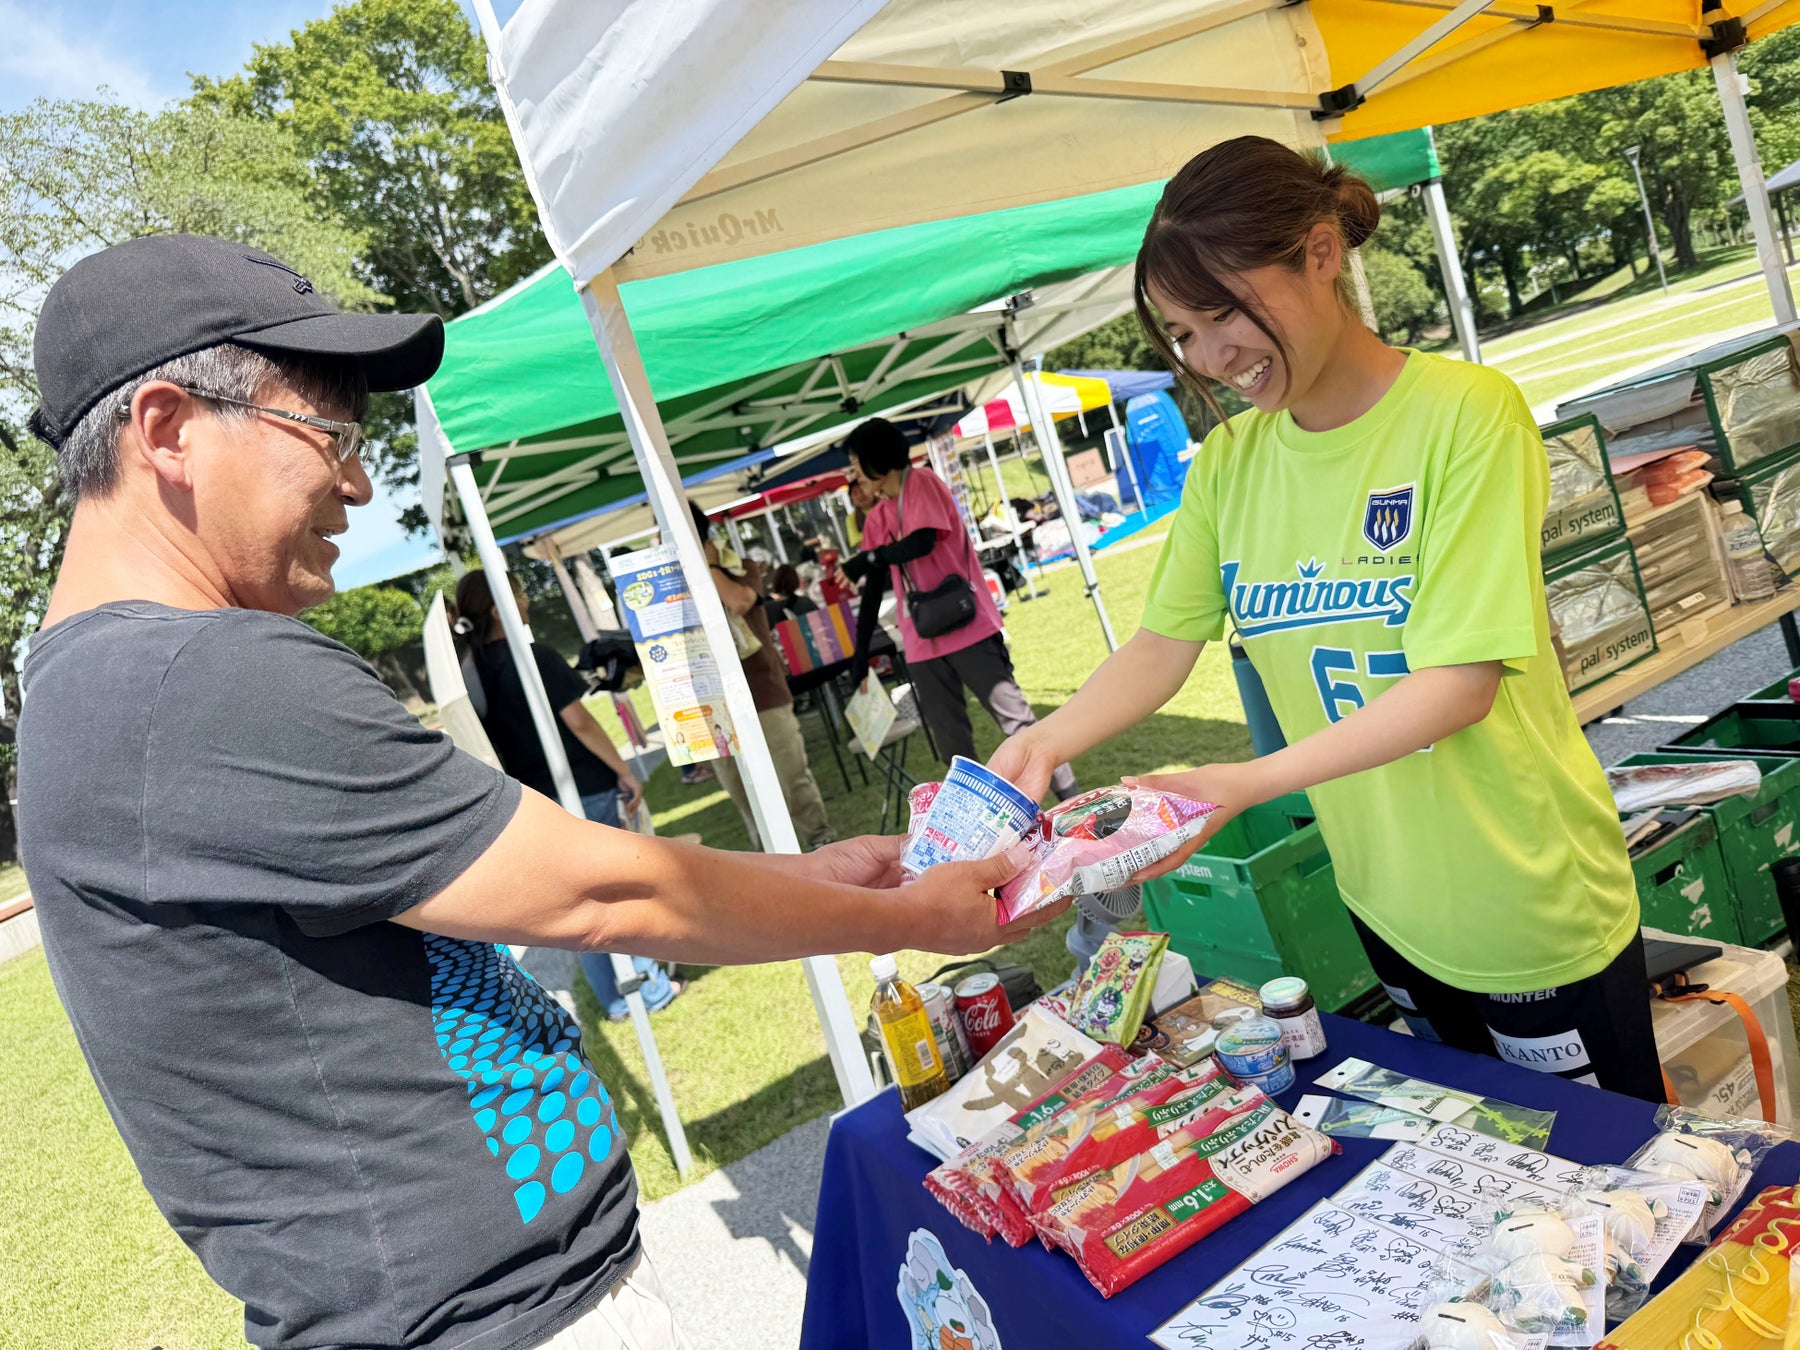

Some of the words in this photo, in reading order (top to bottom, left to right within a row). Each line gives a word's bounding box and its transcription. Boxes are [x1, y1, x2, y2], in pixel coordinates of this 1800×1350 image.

[1371, 498, 1409, 507] GUNMA
[1568, 503, 1616, 537] system
[1580, 648, 1601, 675] pal
[1604, 627, 1650, 660] system
[963, 996, 1000, 1032] Cola
[1503, 1041, 1582, 1065] KANTO
[1217, 1115, 1299, 1171] スパゲッティ
[1272, 1154, 1299, 1175] SHOWA
[1113, 1212, 1161, 1247] 結束タイプ
